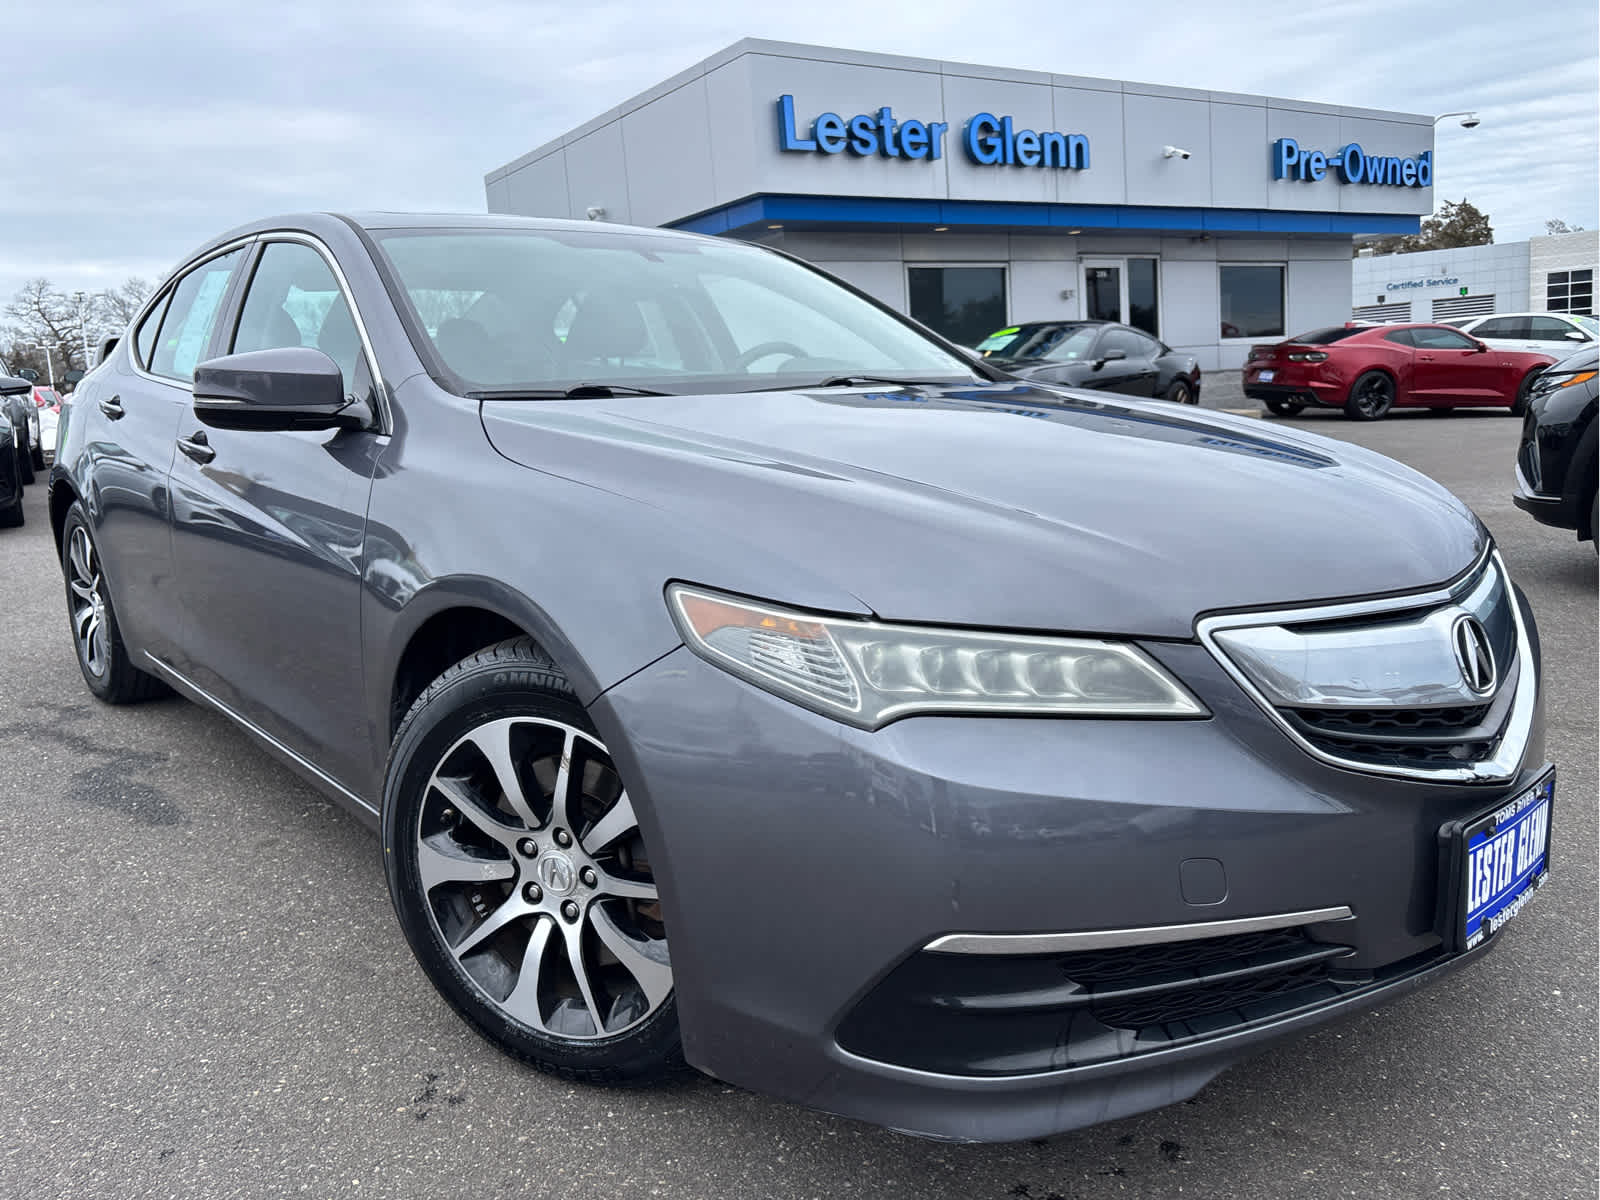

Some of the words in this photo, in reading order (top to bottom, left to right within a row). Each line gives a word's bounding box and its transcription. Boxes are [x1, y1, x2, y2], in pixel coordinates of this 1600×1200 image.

[776, 94, 948, 161] Lester
[963, 112, 1090, 169] Glenn
[1273, 138, 1433, 187] Pre-Owned
[1386, 280, 1424, 292] Certified
[1426, 277, 1459, 287] Service
[1495, 803, 1516, 826] TOMS
[1467, 828, 1516, 914] LESTER
[1516, 799, 1549, 877] GLENN
